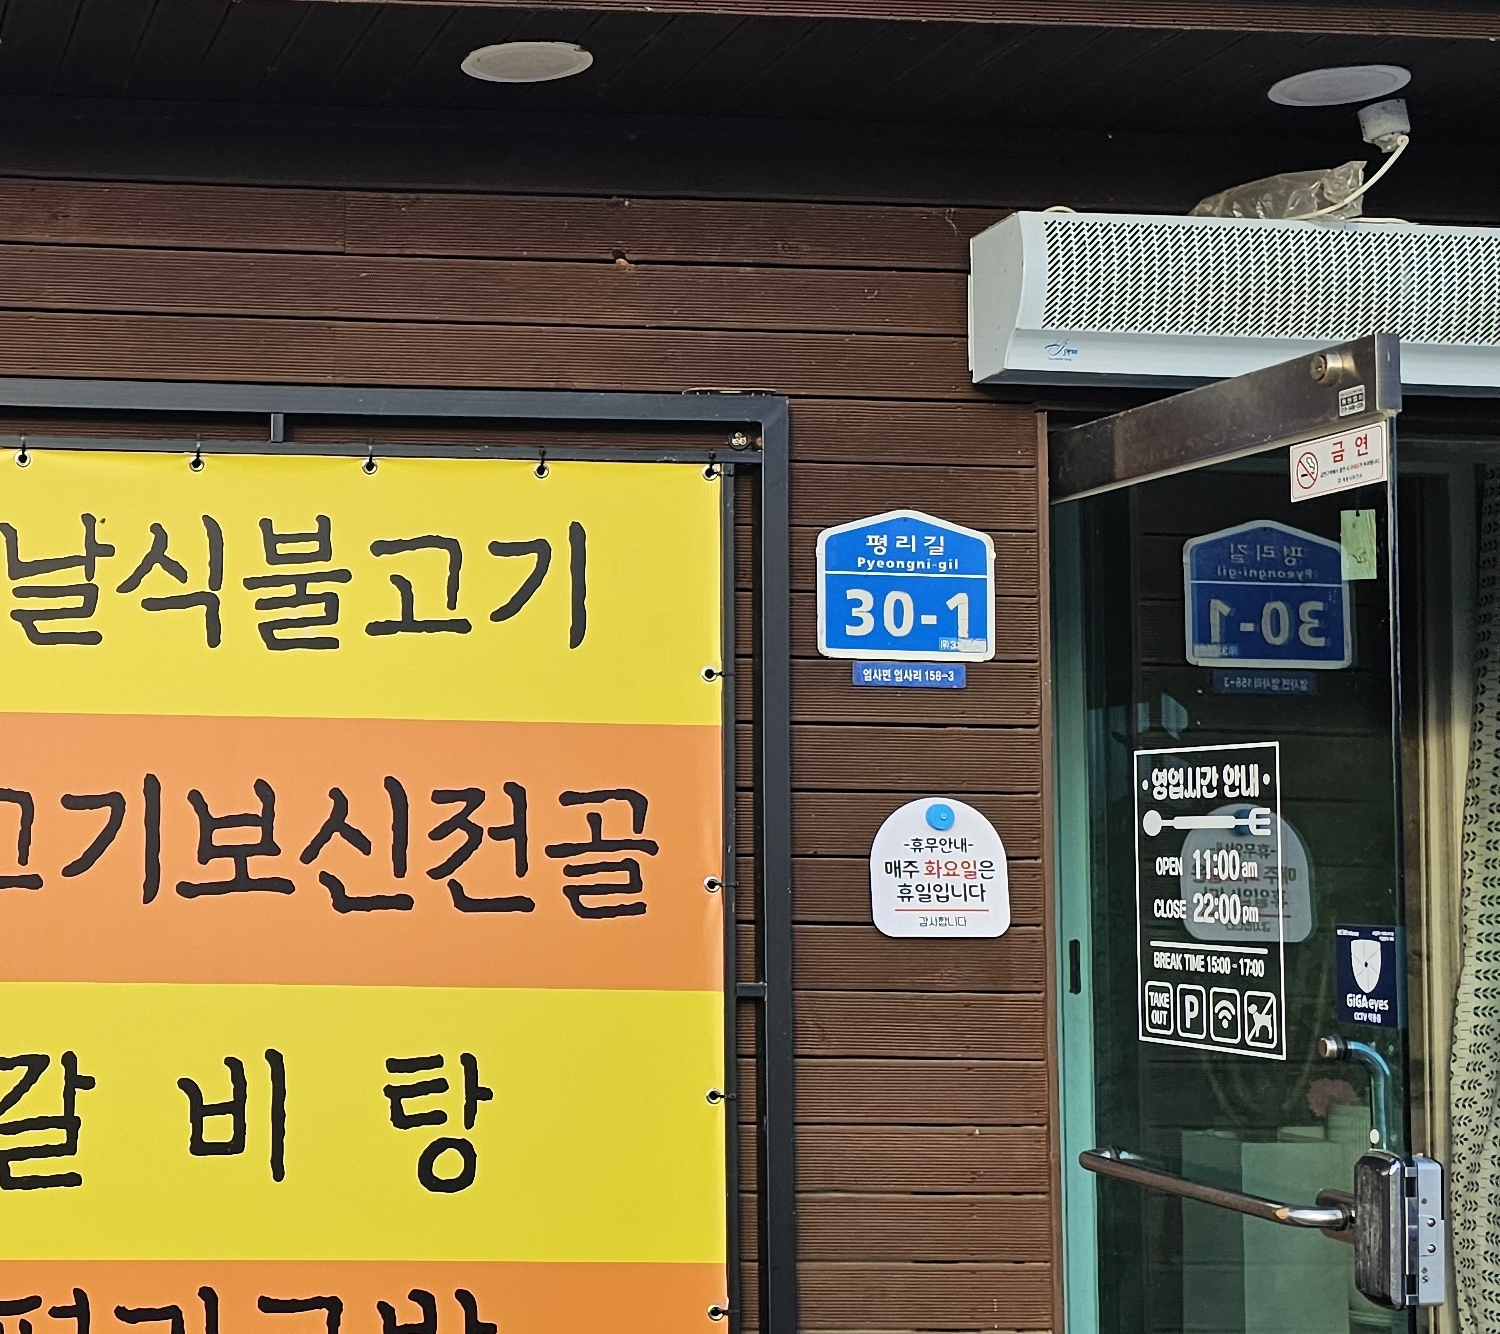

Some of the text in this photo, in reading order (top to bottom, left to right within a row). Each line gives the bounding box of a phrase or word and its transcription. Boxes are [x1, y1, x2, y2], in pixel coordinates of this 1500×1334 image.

[865, 534, 945, 557] 평리길
[857, 556, 959, 573] Pyeongni-gil
[845, 588, 970, 638] 30-1
[924, 669, 955, 682] 158-3
[1151, 763, 1260, 800] 영업시간 안내
[884, 859, 996, 880] 매주 화요일은
[1155, 856, 1184, 876] OPEN
[897, 882, 986, 903] 휴일입니다
[1153, 898, 1187, 919] CLOSE
[918, 916, 967, 927] 감사합니다
[1153, 951, 1183, 971] BREAK
[1184, 953, 1205, 973] TIME
[1206, 955, 1231, 975] 15:00
[1239, 957, 1265, 978] 17:00
[1149, 991, 1170, 1009] TAKE
[1151, 1009, 1168, 1026] OUT
